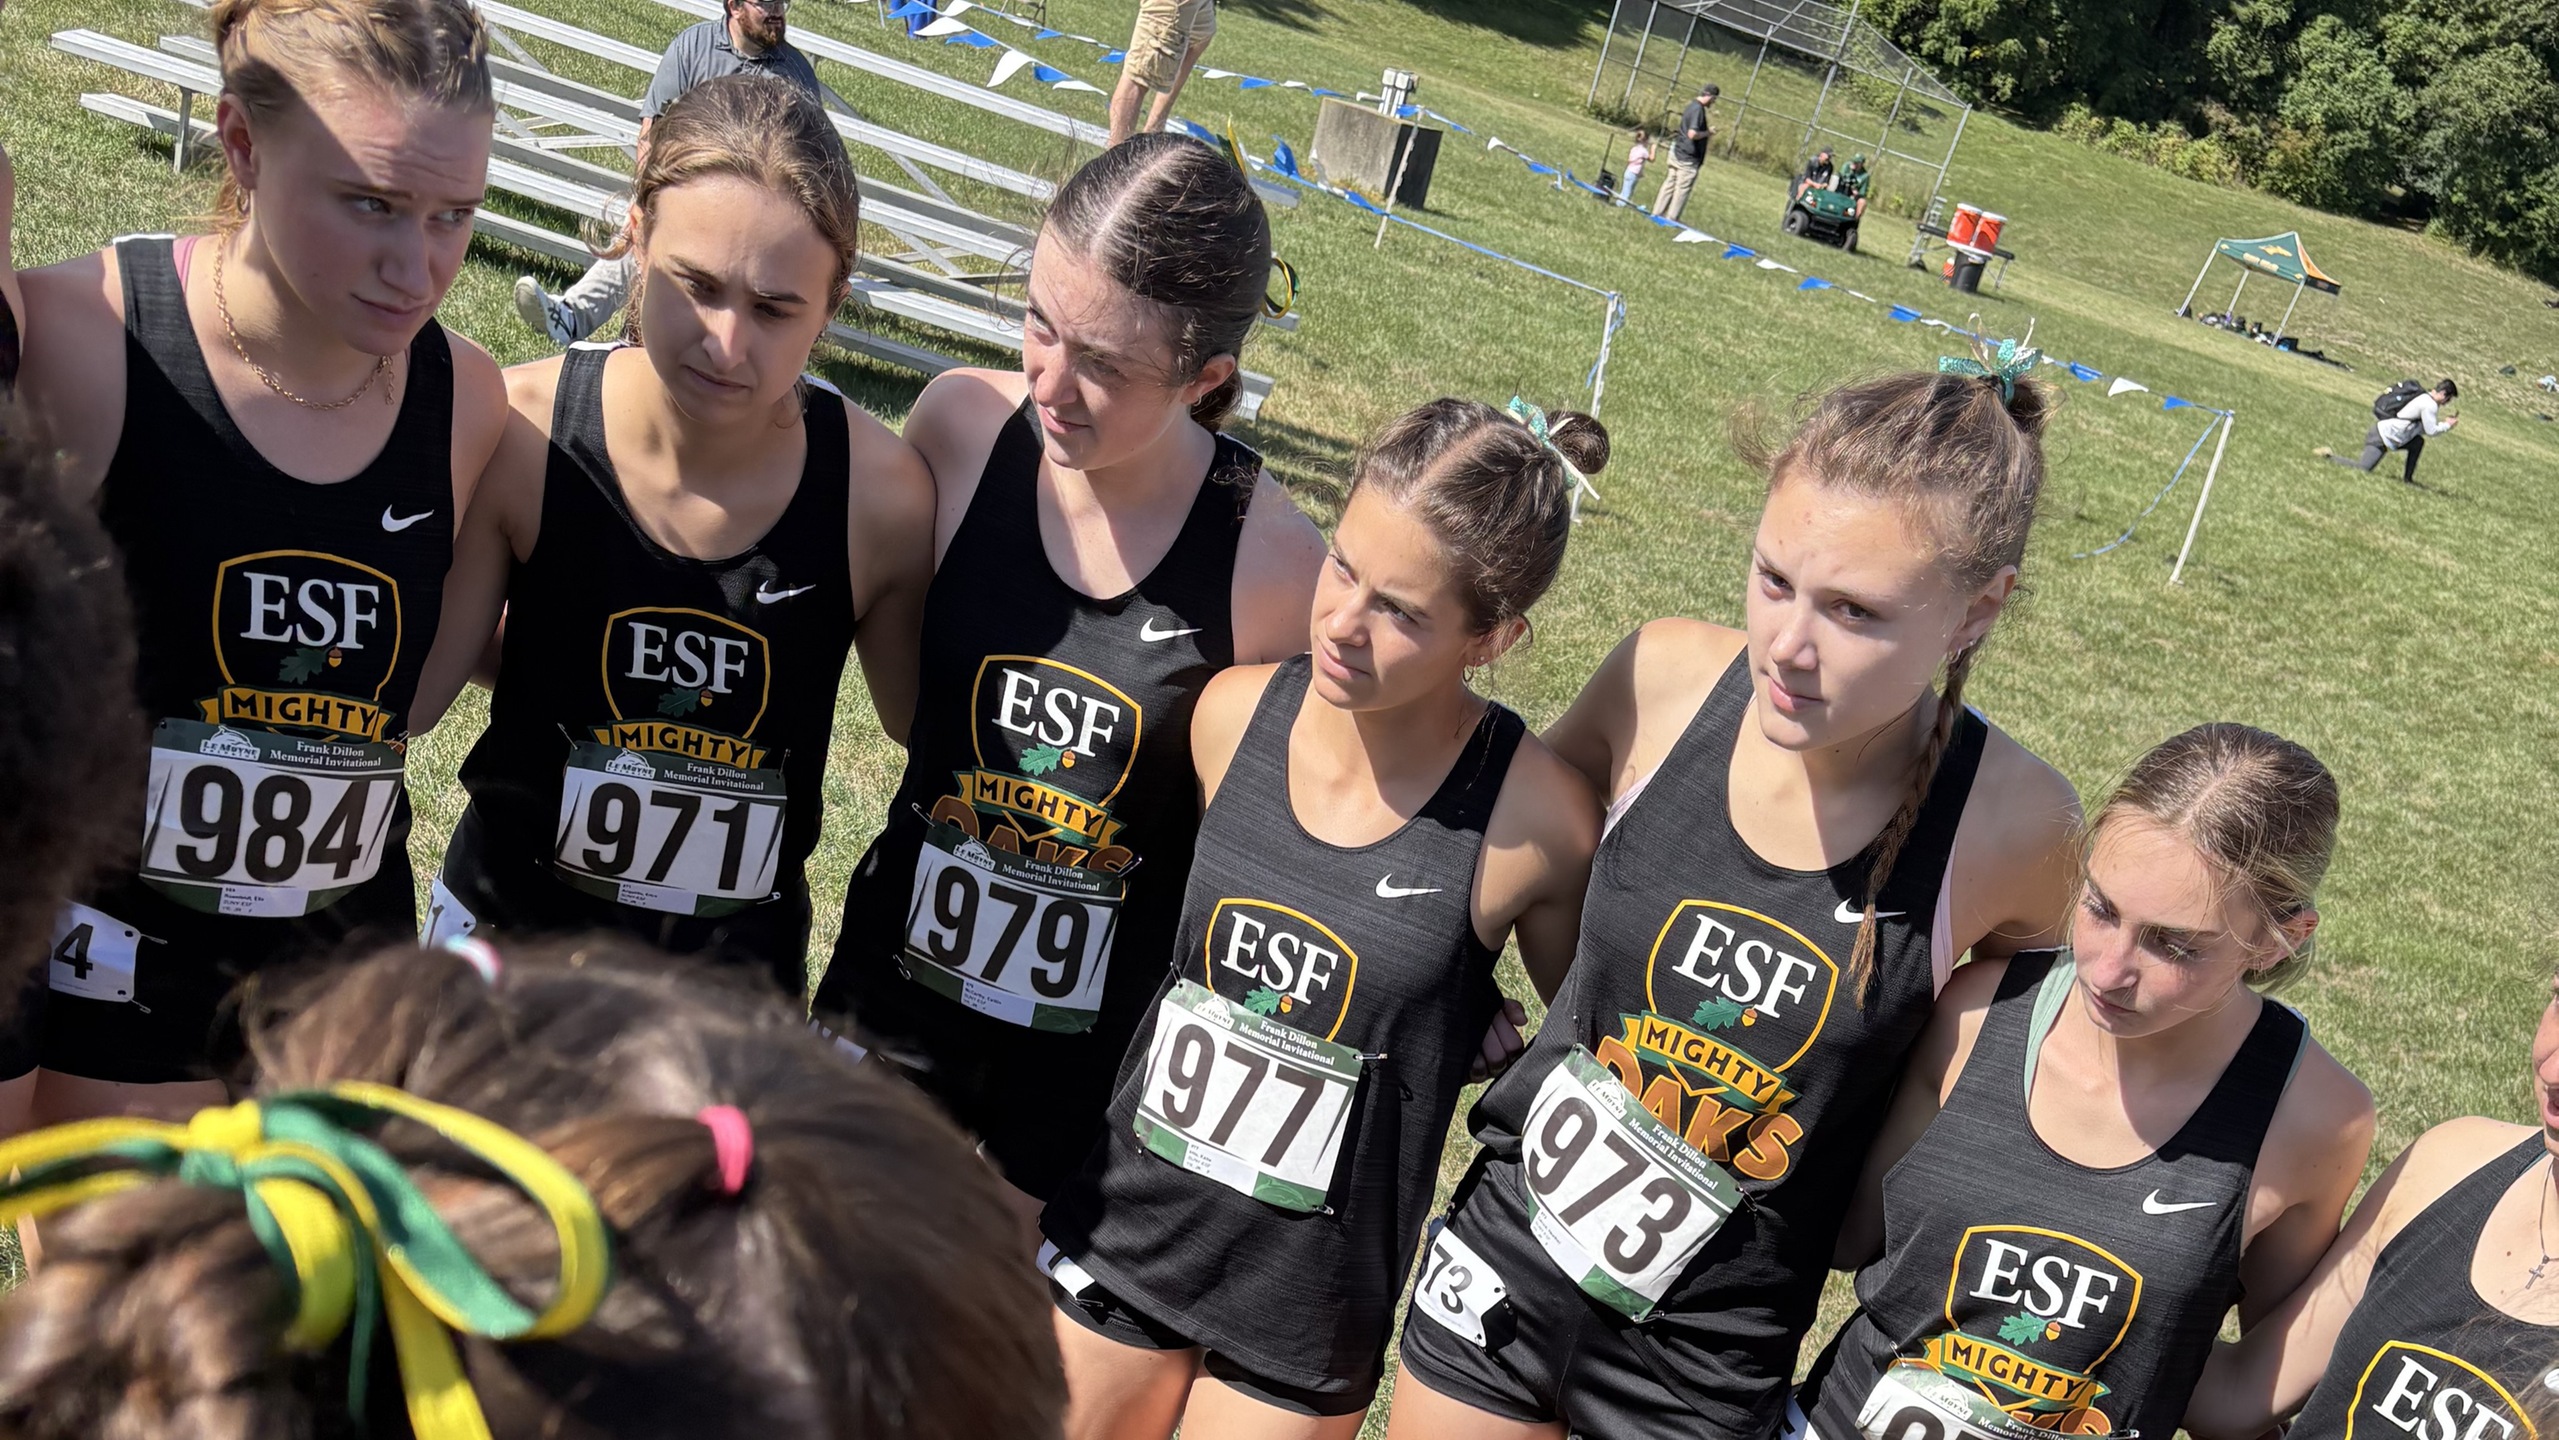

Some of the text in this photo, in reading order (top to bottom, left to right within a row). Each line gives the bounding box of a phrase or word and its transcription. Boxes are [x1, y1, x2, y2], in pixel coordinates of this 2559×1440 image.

[240, 571, 380, 650] ESF
[625, 621, 748, 694] ESF
[229, 690, 377, 734] MIGHTY
[619, 724, 748, 764] MIGHTY
[991, 667, 1120, 758] ESF
[270, 749, 323, 765] Memorial
[325, 756, 381, 768] Invitational
[296, 741, 365, 757] Frank Dillon
[663, 769, 710, 785] Memorial
[711, 777, 764, 791] Invitational
[687, 762, 747, 780] Frank Dillon
[176, 764, 371, 884] 984
[979, 774, 1102, 832] MIGHTY
[582, 782, 750, 891] 971
[1002, 863, 1100, 892] Memorial Invitational
[1024, 859, 1084, 879] Frank Dillon
[54, 923, 93, 980] 4
[927, 865, 1090, 999] 979
[1220, 910, 1338, 1005] ESF
[1671, 913, 1818, 1019] ESF
[1238, 1022, 1336, 1066] Memorial Invitational
[1260, 1020, 1318, 1050] Frank Dillon
[1645, 1024, 1776, 1100] MIGHTY
[1162, 1023, 1327, 1168] 977
[1595, 1034, 1804, 1181] OAKS
[1628, 1118, 1720, 1190] Memorial Invitational
[1652, 1123, 1707, 1169] Frank Dillon
[1527, 1096, 1692, 1275] 973
[1424, 1242, 1473, 1314] 73
[1969, 1238, 2119, 1329] ESF
[1951, 1336, 2087, 1400] MIGHTY
[1976, 1416, 2028, 1440] Memorial
[2004, 1417, 2037, 1436] Frank
